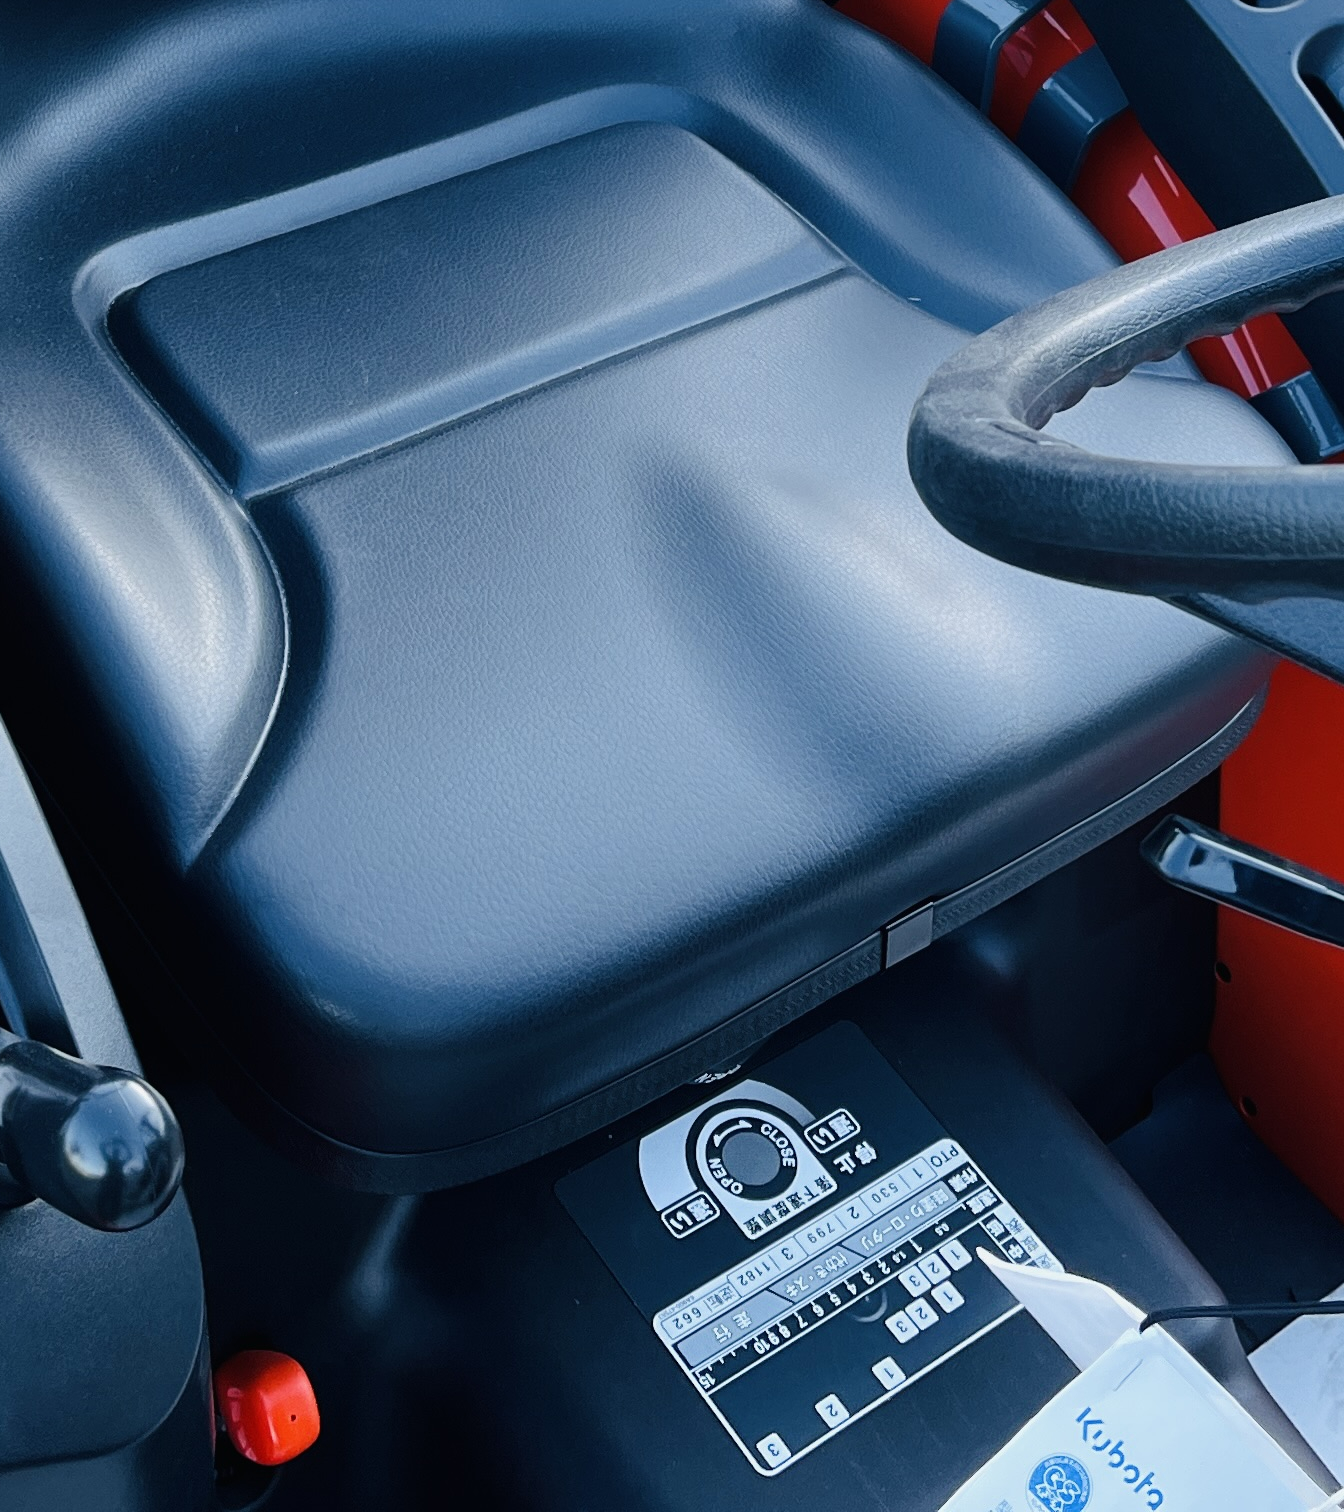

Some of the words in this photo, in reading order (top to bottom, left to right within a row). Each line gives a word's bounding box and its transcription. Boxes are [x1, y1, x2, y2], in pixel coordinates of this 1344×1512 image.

[809, 1112, 854, 1150] 遅い
[759, 1123, 793, 1167] CLOSE
[832, 1138, 878, 1178] 停止
[928, 1143, 959, 1169] PTO
[706, 1157, 743, 1194] OPEN
[911, 1165, 923, 1179] 1
[946, 1165, 979, 1194] 作業
[869, 1181, 898, 1204] 530
[741, 1173, 833, 1237] 落下速度調整
[964, 1187, 997, 1216] 速度
[666, 1195, 714, 1235] 速い
[845, 1204, 860, 1220] 2
[805, 1220, 834, 1245] 799
[779, 1245, 794, 1262] 3
[949, 1248, 960, 1261] 1
[1004, 1240, 1025, 1261] 中
[736, 1259, 771, 1287] 1182
[877, 1260, 891, 1275] 2
[926, 1260, 940, 1275] 2
[860, 1270, 875, 1286] 3
[907, 1273, 920, 1288] 3
[705, 1283, 736, 1310] 逆転
[845, 1281, 859, 1296] 4
[942, 1289, 953, 1303] 1
[828, 1292, 841, 1307] 5
[670, 1305, 702, 1330] 662
[811, 1302, 825, 1318] 6
[914, 1306, 927, 1320] 2
[794, 1313, 808, 1328] 7
[894, 1319, 907, 1334] 3
[766, 1330, 780, 1346] 9
[777, 1323, 792, 1339] 8
[751, 1336, 771, 1356] 10
[696, 1370, 717, 1390] 15
[882, 1364, 895, 1380] 1
[823, 1402, 838, 1418] 2
[765, 1441, 780, 1458] 3
[1076, 1407, 1163, 1510] Kubota
